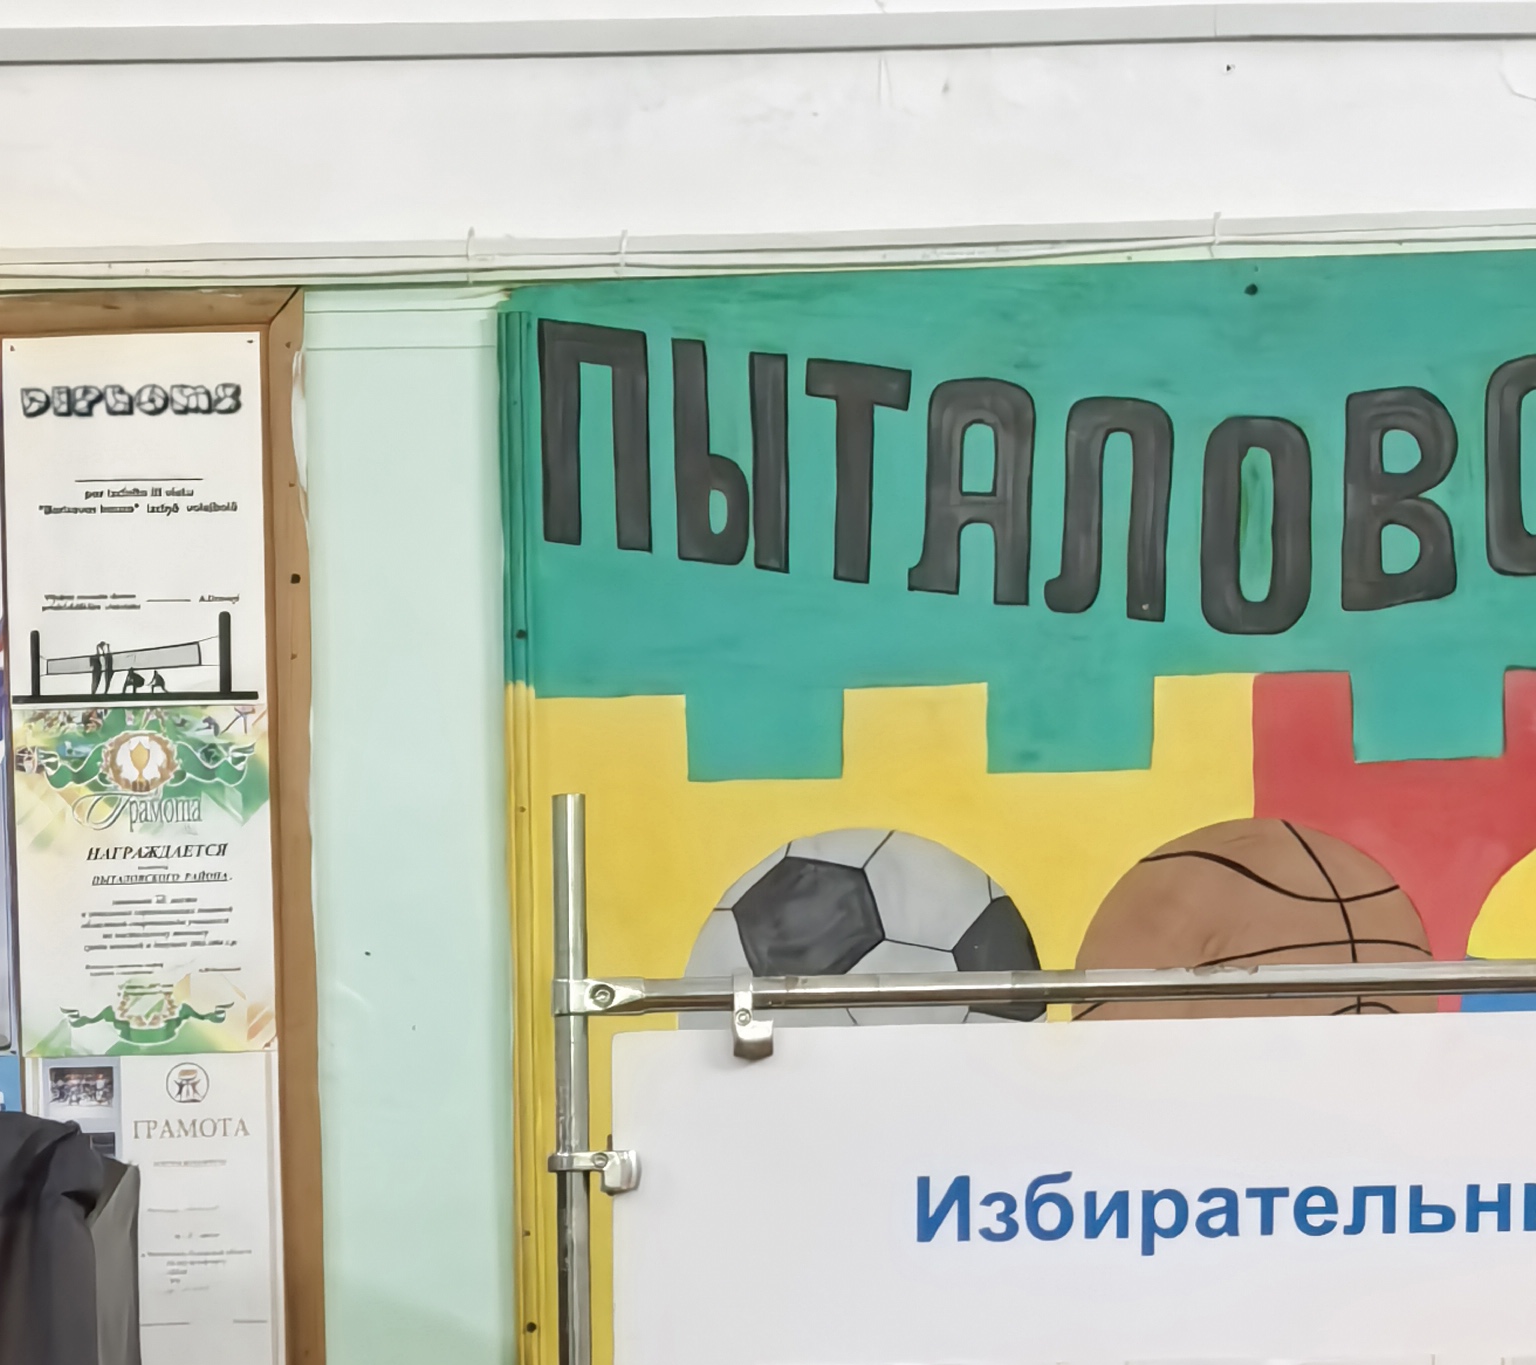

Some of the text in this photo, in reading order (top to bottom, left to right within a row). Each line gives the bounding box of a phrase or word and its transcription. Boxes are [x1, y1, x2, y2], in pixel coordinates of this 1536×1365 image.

[86, 842, 230, 861] НАГРАЖДАЕТСЯ
[132, 1117, 251, 1140] ГРАМОТА
[916, 1170, 1536, 1256] Избирательн
